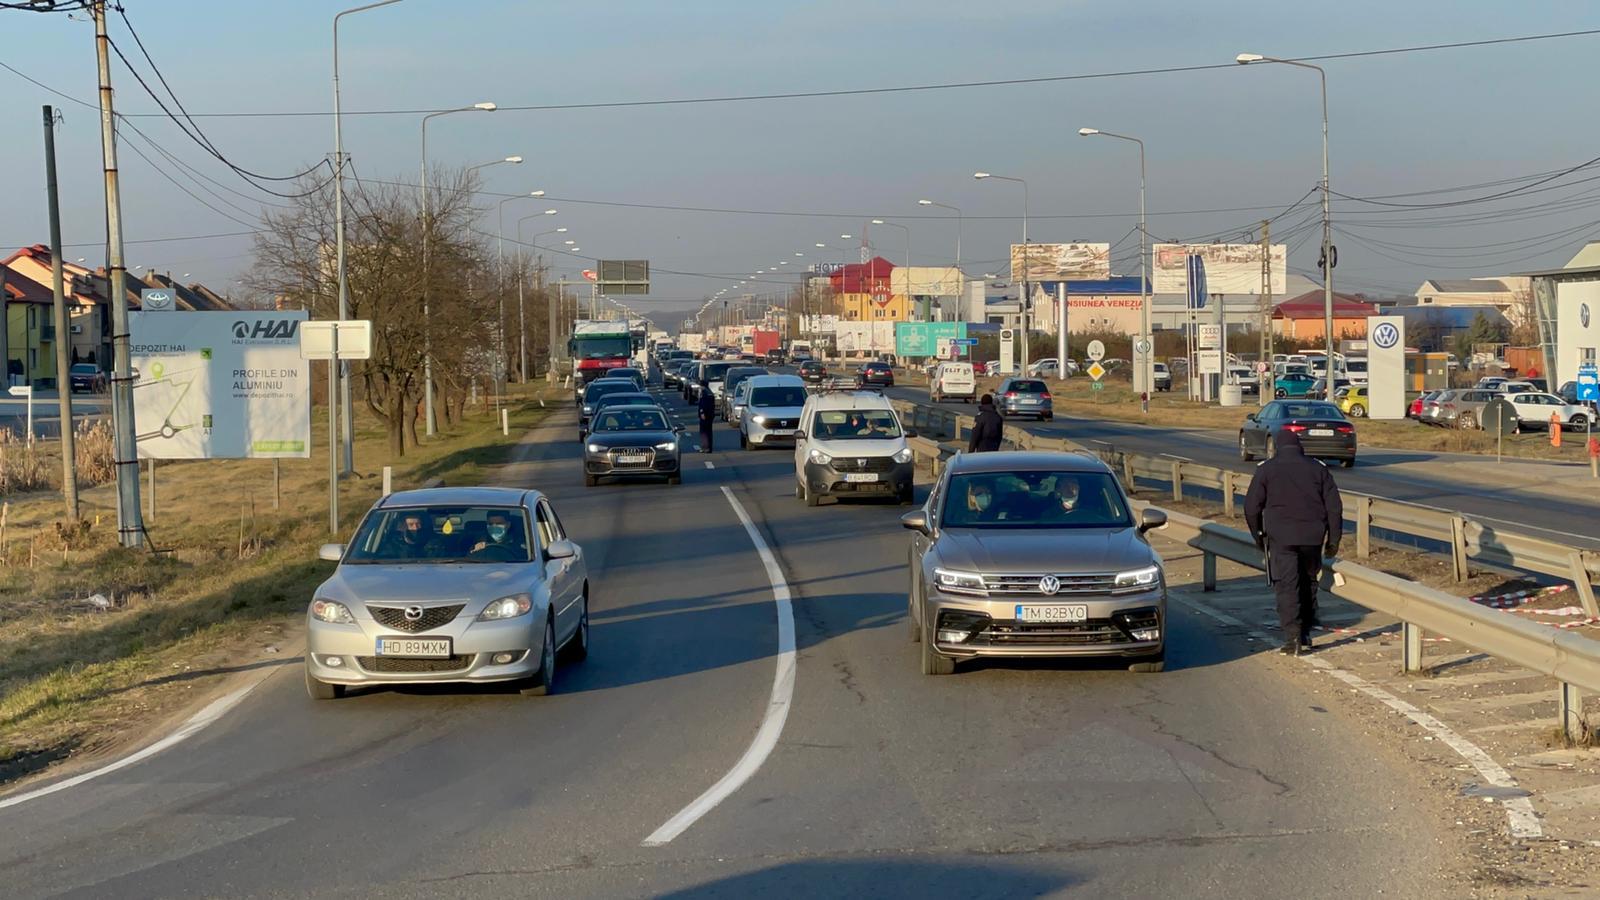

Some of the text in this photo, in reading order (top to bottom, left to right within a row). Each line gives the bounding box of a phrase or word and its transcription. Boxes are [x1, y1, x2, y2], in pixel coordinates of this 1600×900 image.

[250, 319, 299, 339] HAI
[129, 344, 186, 353] DEPOZIT HAI
[232, 369, 298, 378] PROFILE DIN
[232, 381, 283, 390] ALUMINIU
[1023, 607, 1041, 619] TM
[383, 641, 400, 653] HD
